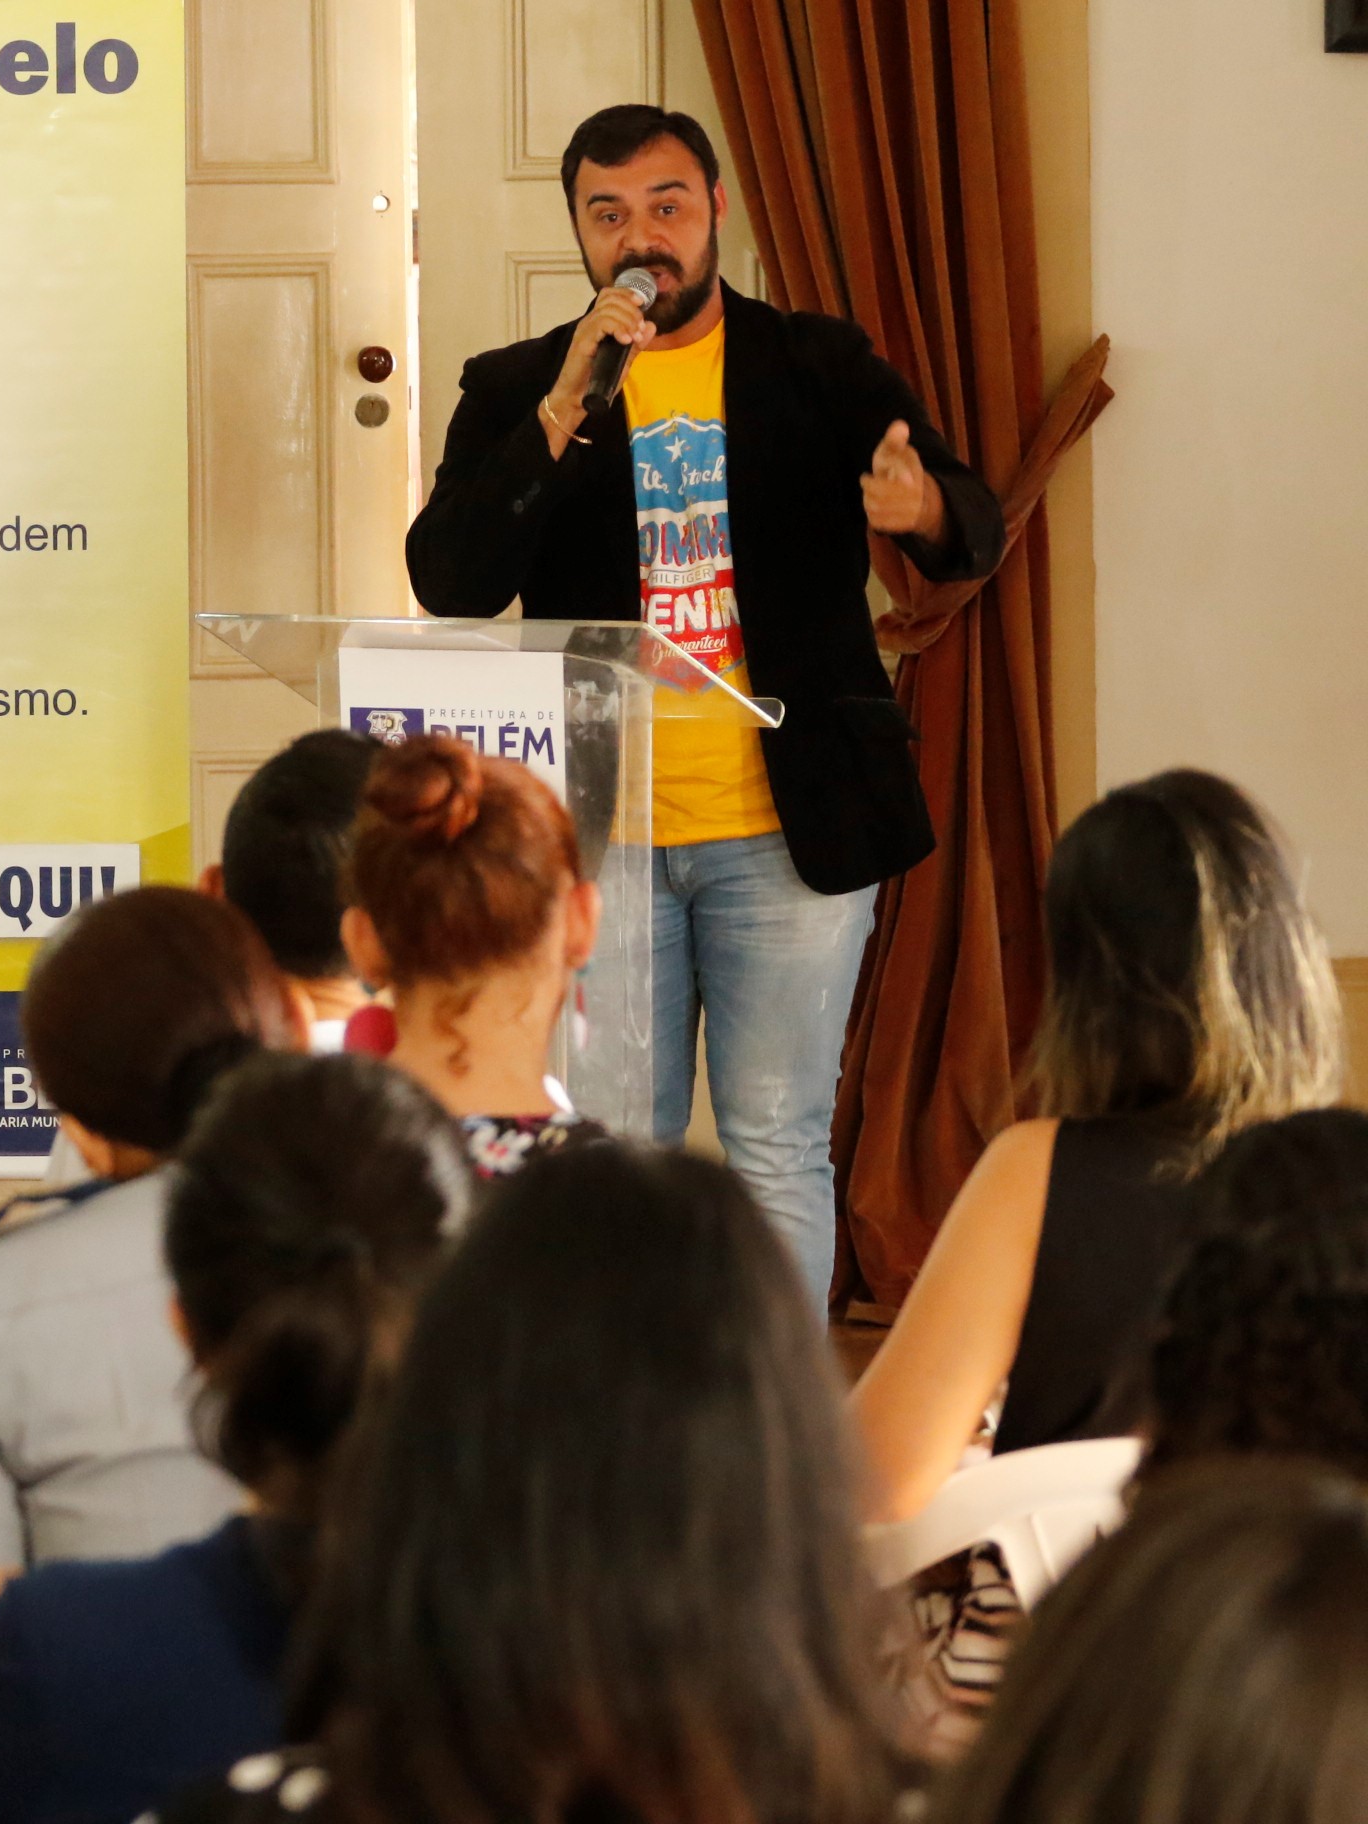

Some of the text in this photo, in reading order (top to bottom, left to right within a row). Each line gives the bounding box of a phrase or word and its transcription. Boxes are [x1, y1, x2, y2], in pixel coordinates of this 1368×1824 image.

[650, 567, 712, 585] HILFIGER
[429, 708, 554, 720] PREFEITURA DE
